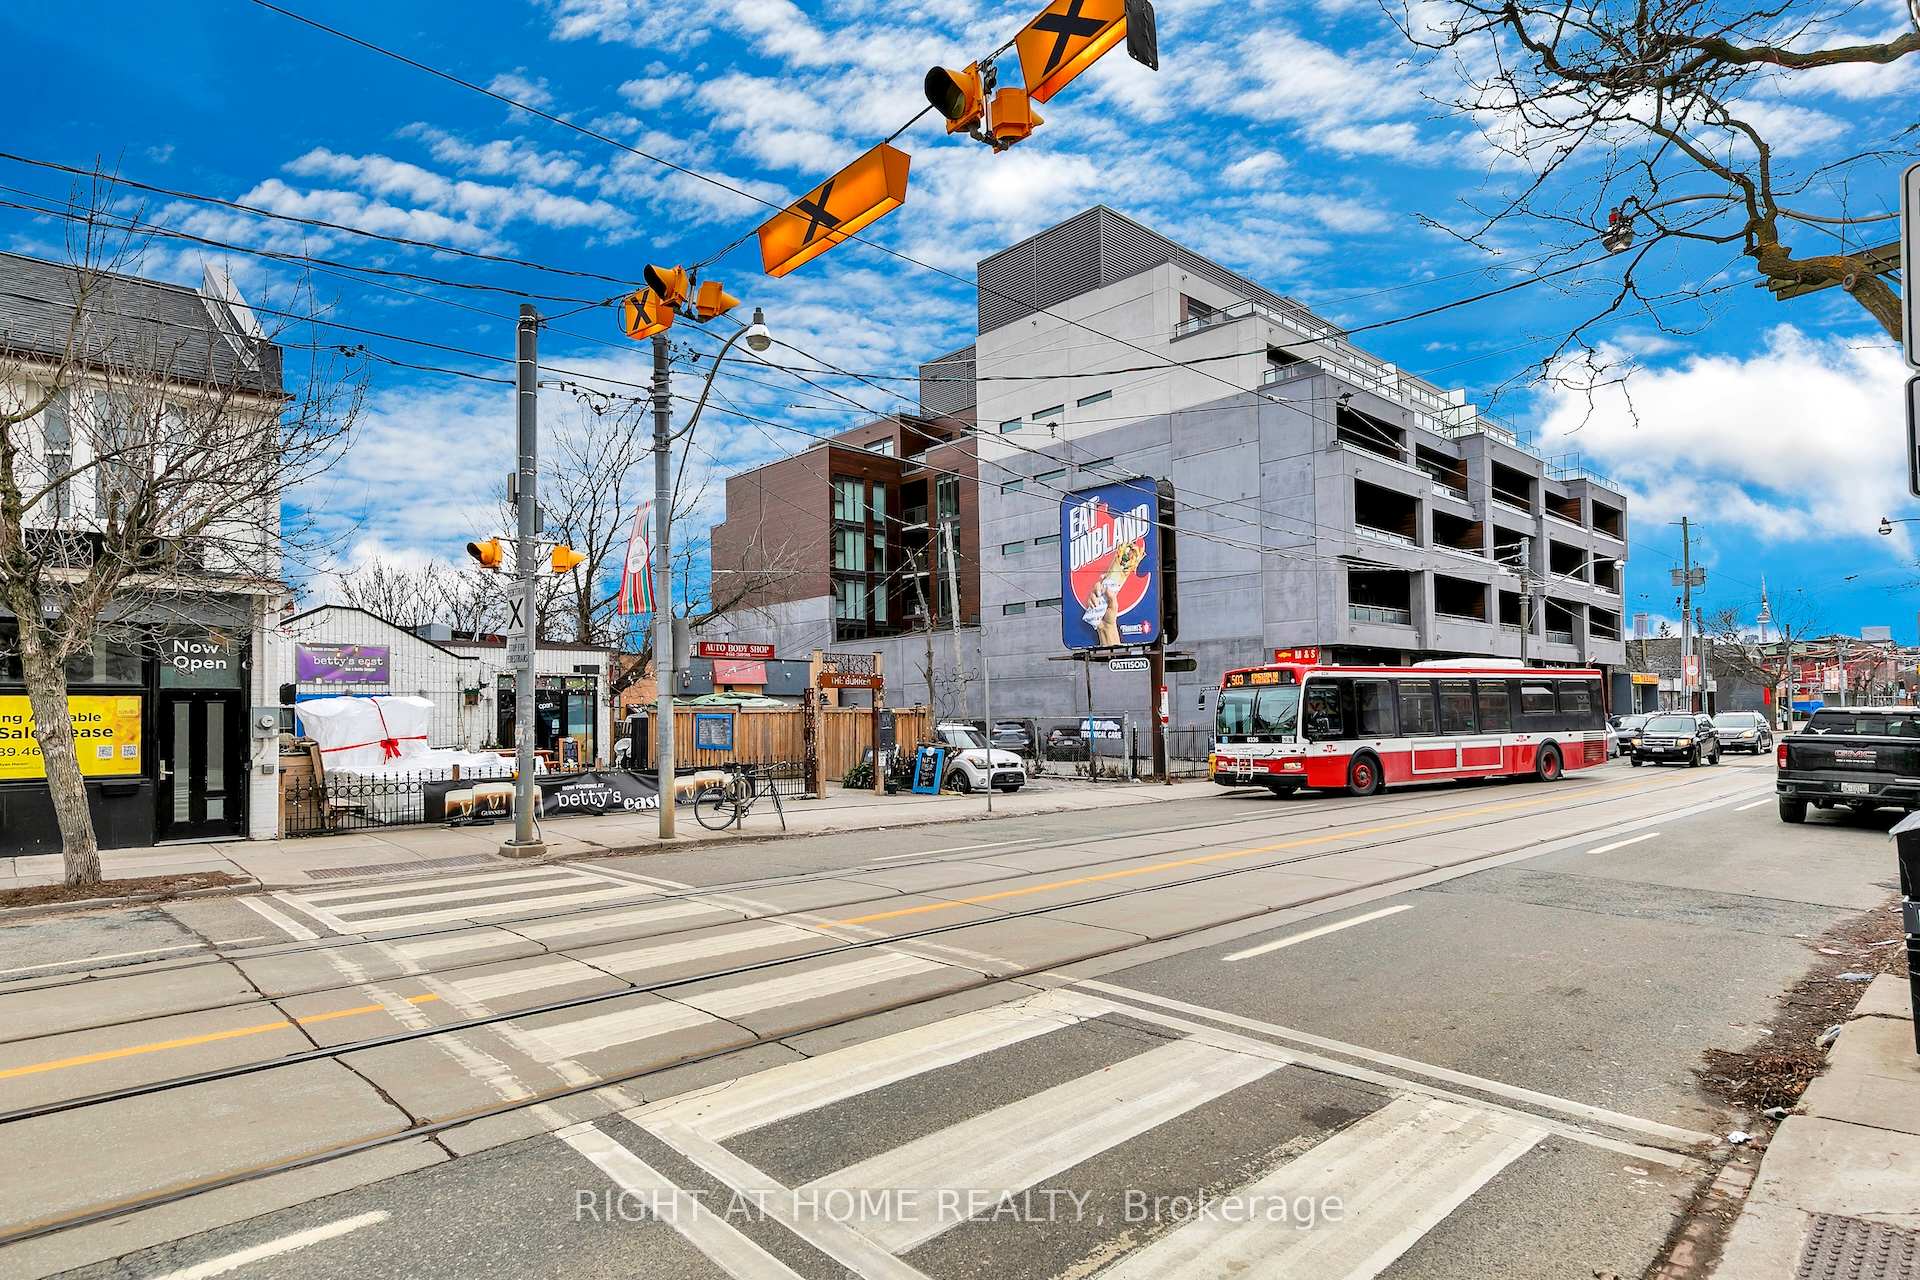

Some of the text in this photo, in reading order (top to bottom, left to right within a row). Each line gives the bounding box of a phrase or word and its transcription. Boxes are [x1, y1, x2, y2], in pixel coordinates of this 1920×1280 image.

[1070, 497, 1099, 540] EAT
[1070, 504, 1149, 571] UNBLAND
[173, 640, 219, 654] Now
[705, 643, 769, 654] AUTO BODY SHOP
[1304, 650, 1310, 658] &
[173, 656, 227, 672] Open
[313, 656, 384, 666] betty's east
[1112, 660, 1147, 670] PATTISON
[1232, 674, 1244, 685] 503
[1108, 731, 1122, 739] CARE
[1834, 749, 1877, 759] GMC
[555, 788, 660, 810] betty's east
